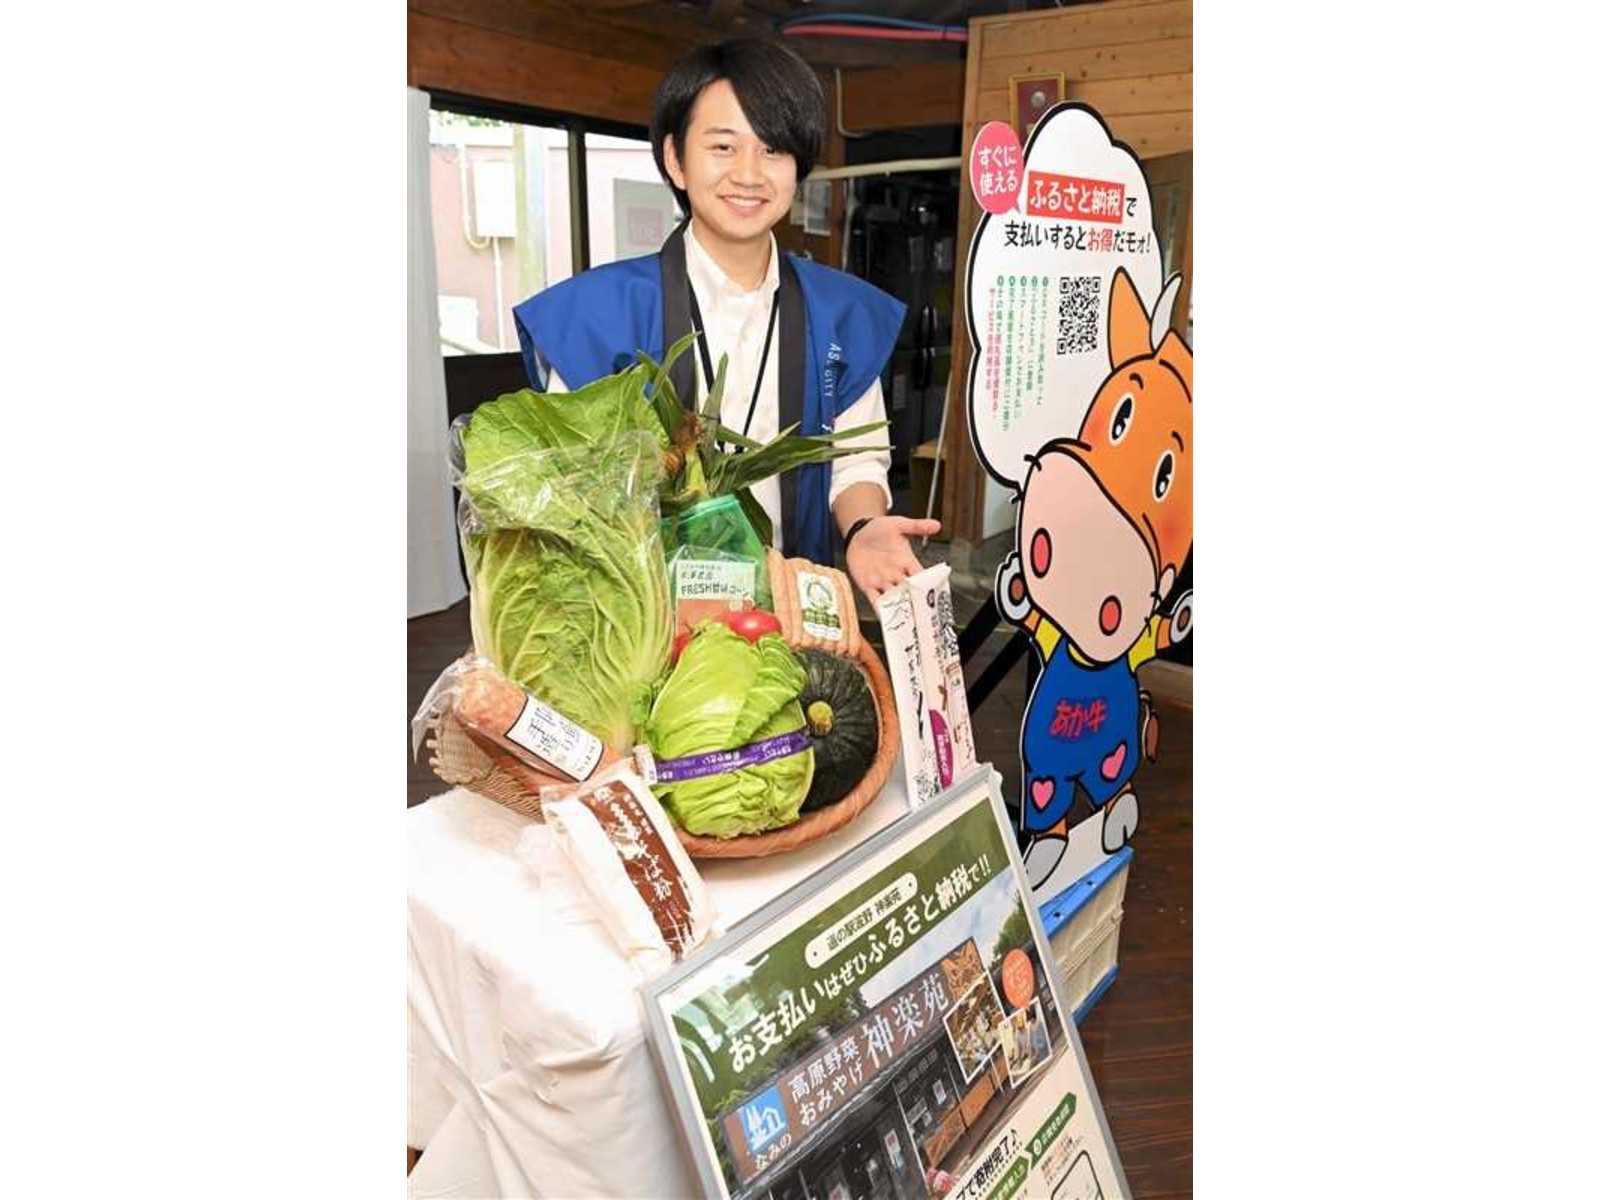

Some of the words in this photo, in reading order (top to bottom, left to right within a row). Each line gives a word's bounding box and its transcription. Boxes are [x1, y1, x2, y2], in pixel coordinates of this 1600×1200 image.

[978, 145, 1017, 169] すぐに
[980, 169, 1019, 197] 使える
[1049, 699, 1108, 741] あか牛
[861, 973, 949, 1069] 神楽苑
[788, 1036, 860, 1104] 高原野菜
[800, 1058, 864, 1126] おみやげ
